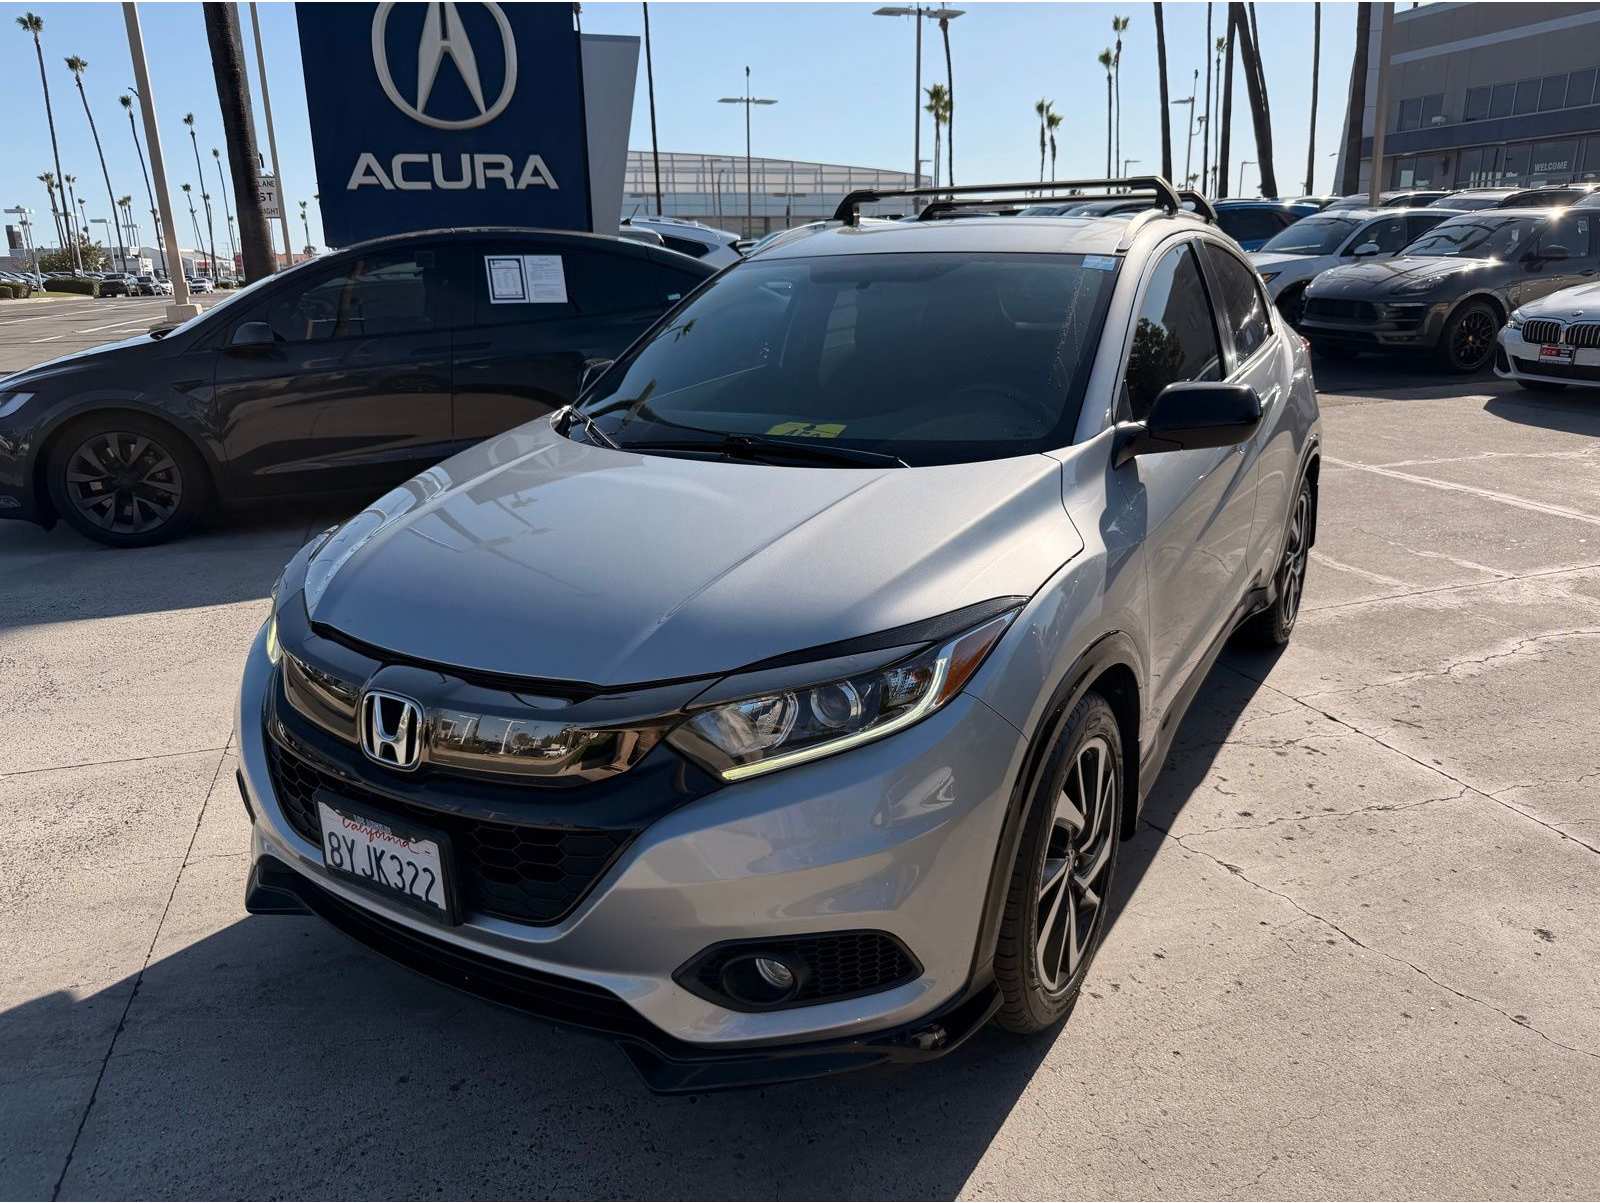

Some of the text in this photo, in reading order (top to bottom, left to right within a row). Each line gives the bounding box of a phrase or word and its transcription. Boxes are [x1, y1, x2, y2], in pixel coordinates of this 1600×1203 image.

[346, 153, 560, 190] ACURA
[1534, 161, 1568, 172] WELCOME
[340, 817, 420, 855] California
[328, 831, 440, 908] 8YJK322
